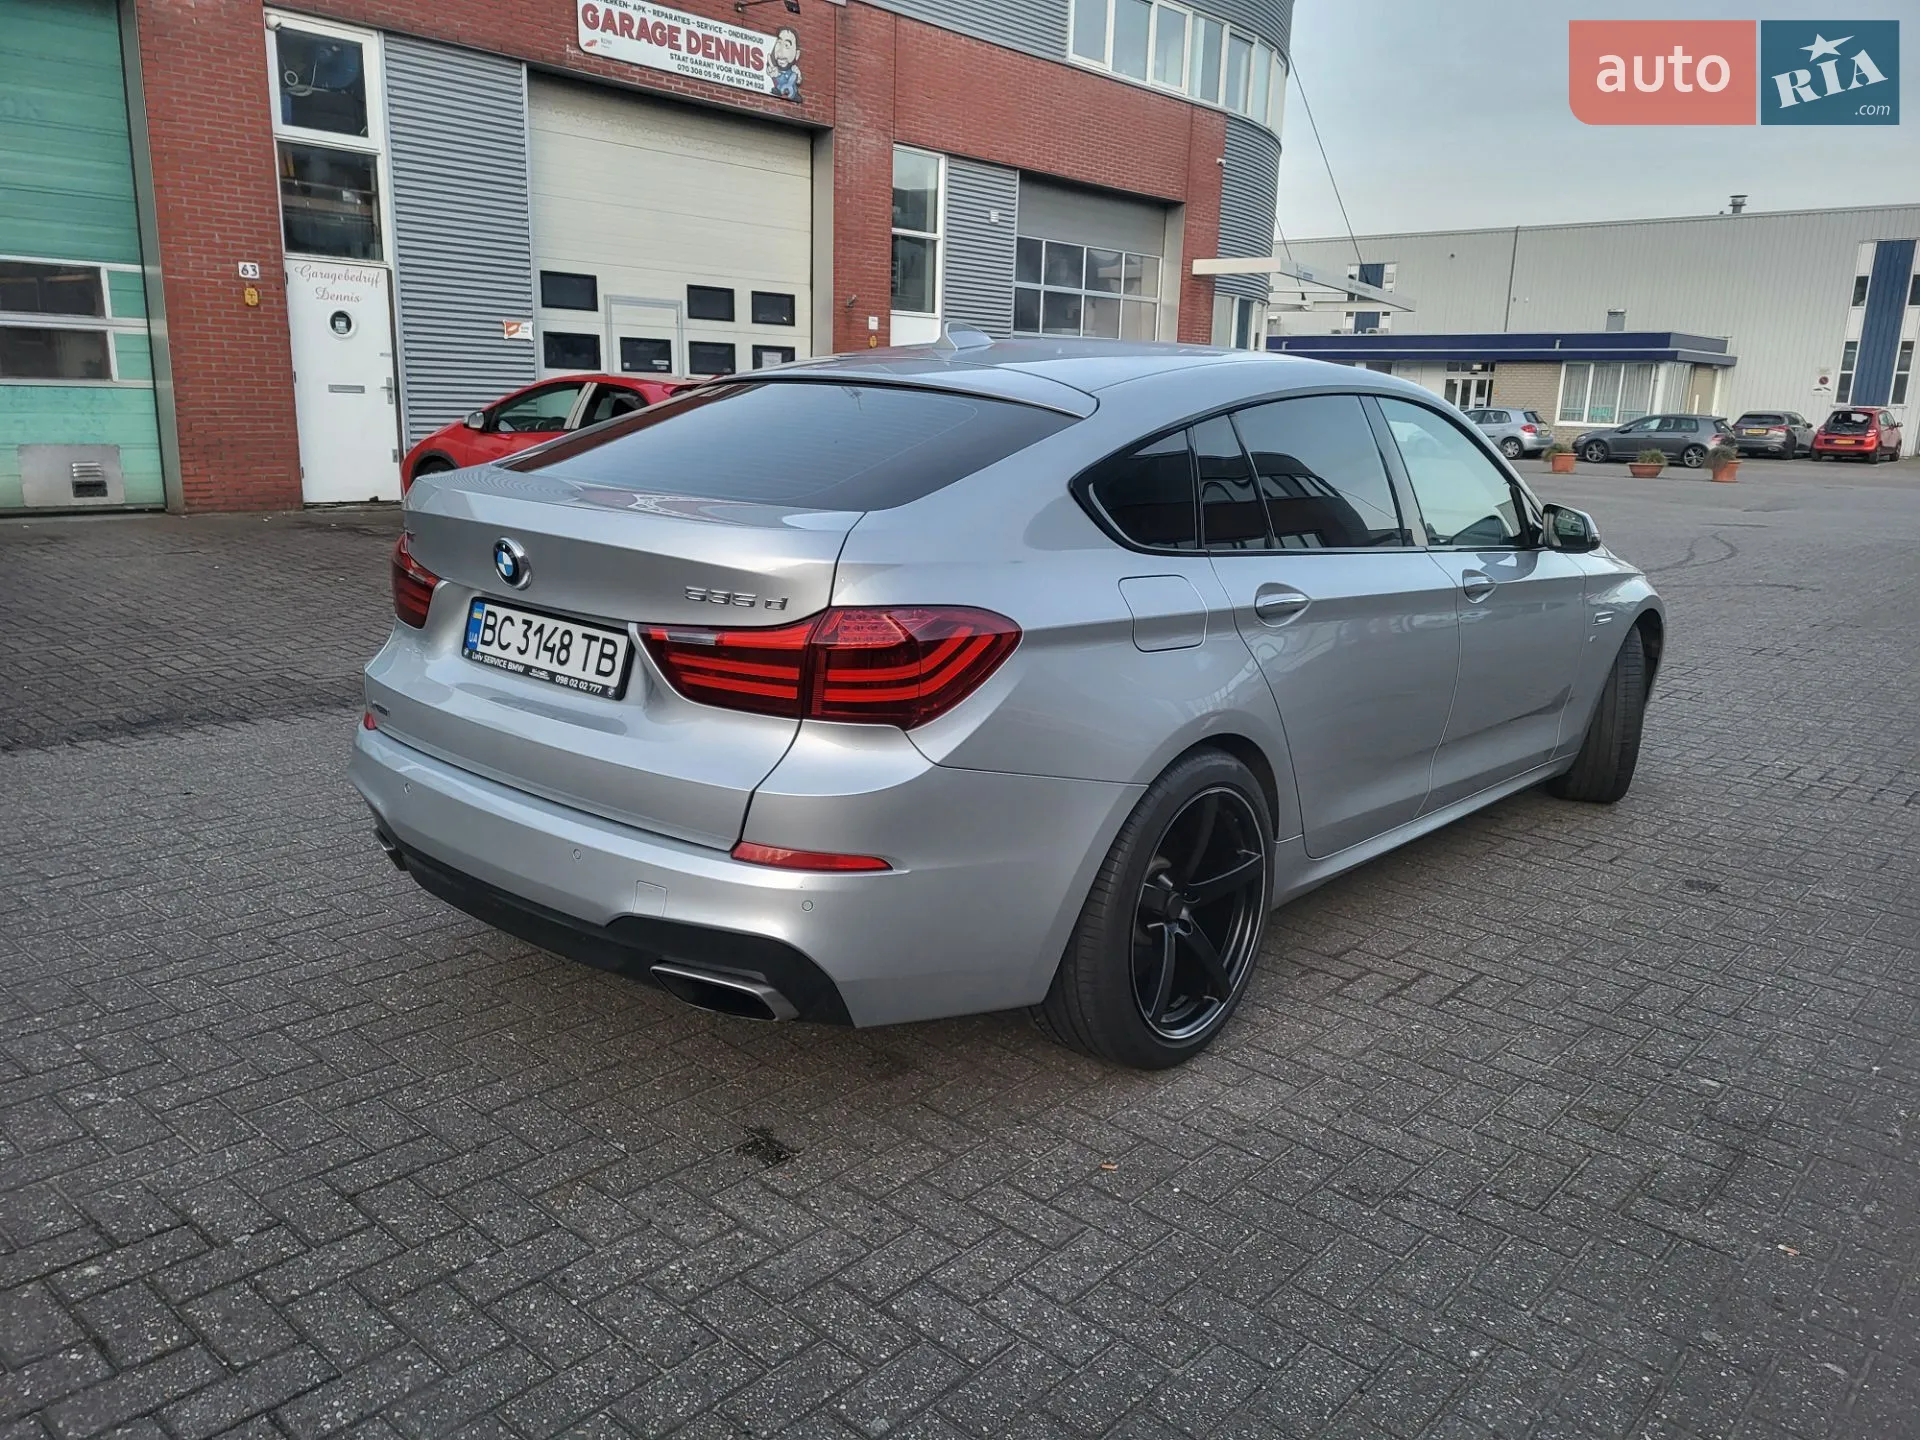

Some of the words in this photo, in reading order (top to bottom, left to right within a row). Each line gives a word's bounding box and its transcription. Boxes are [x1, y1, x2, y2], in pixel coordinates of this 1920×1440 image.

[582, 3, 682, 51] GARAGE
[687, 29, 764, 71] DENNIS
[633, 4, 646, 14] APK
[653, 9, 690, 25] REPARATIES
[696, 21, 722, 34] SERVICE
[728, 30, 763, 44] ONDERHOUD
[670, 53, 688, 64] STAAT
[690, 57, 714, 69] GARANT
[716, 64, 732, 75] VOOR
[734, 69, 764, 81] VAKKENNIS
[677, 64, 689, 72] 070
[691, 66, 702, 75] 308
[240, 264, 258, 277] 63
[294, 264, 381, 288] Garagebedrijf
[315, 287, 362, 303] Dennis
[469, 631, 477, 643] UA
[480, 610, 515, 651] BC
[517, 618, 573, 666] 3148
[582, 633, 618, 677] TB
[472, 651, 483, 661] Lviv
[483, 655, 507, 668] SERVICE
[508, 661, 524, 673] BMW
[556, 675, 568, 685] 098
[569, 678, 578, 688] 02
[579, 681, 588, 690] 02
[589, 683, 602, 693] 777
